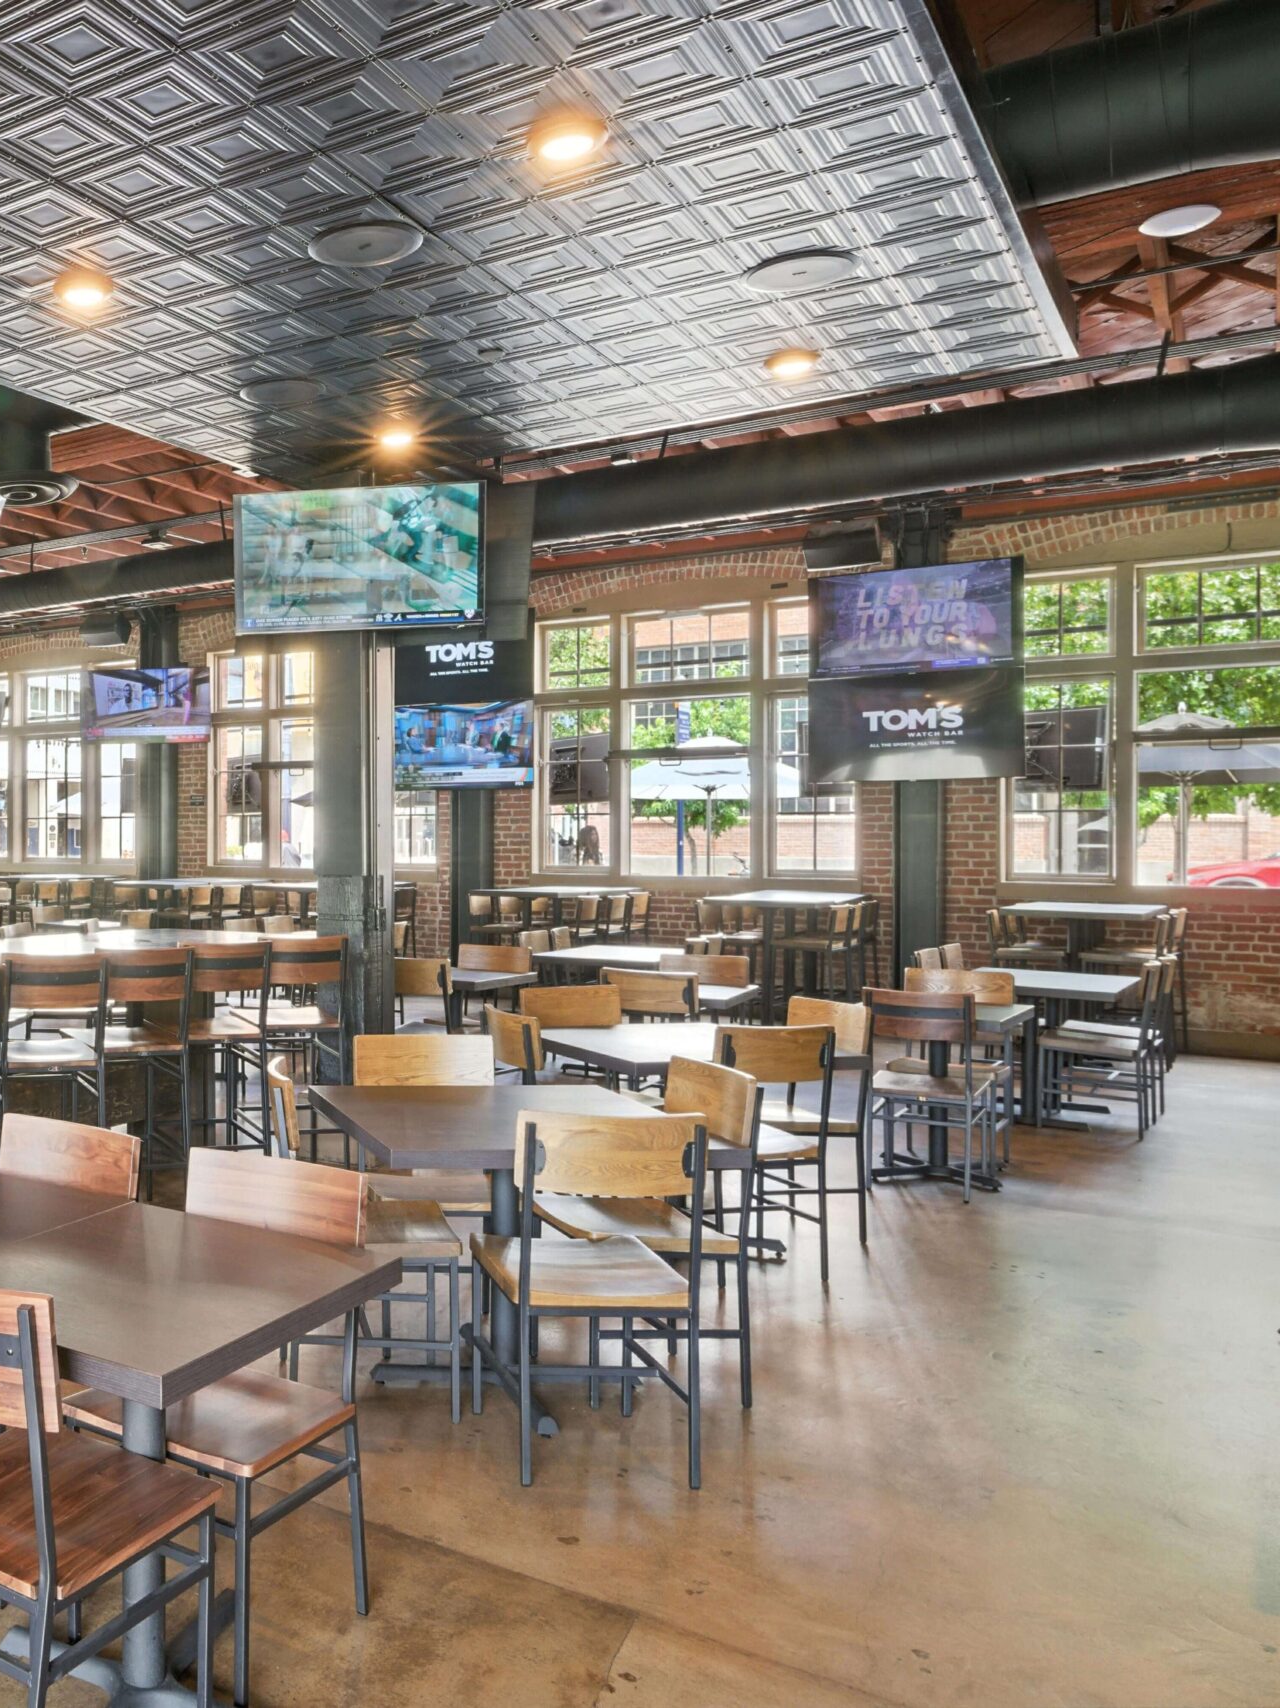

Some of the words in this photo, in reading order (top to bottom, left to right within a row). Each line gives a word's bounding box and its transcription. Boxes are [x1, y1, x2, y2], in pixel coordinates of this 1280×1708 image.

[857, 579, 968, 608] LISTEN
[857, 606, 890, 629] TO
[900, 600, 968, 626] YOUR
[857, 623, 968, 650] LUNGS
[862, 703, 964, 732] TOM'S
